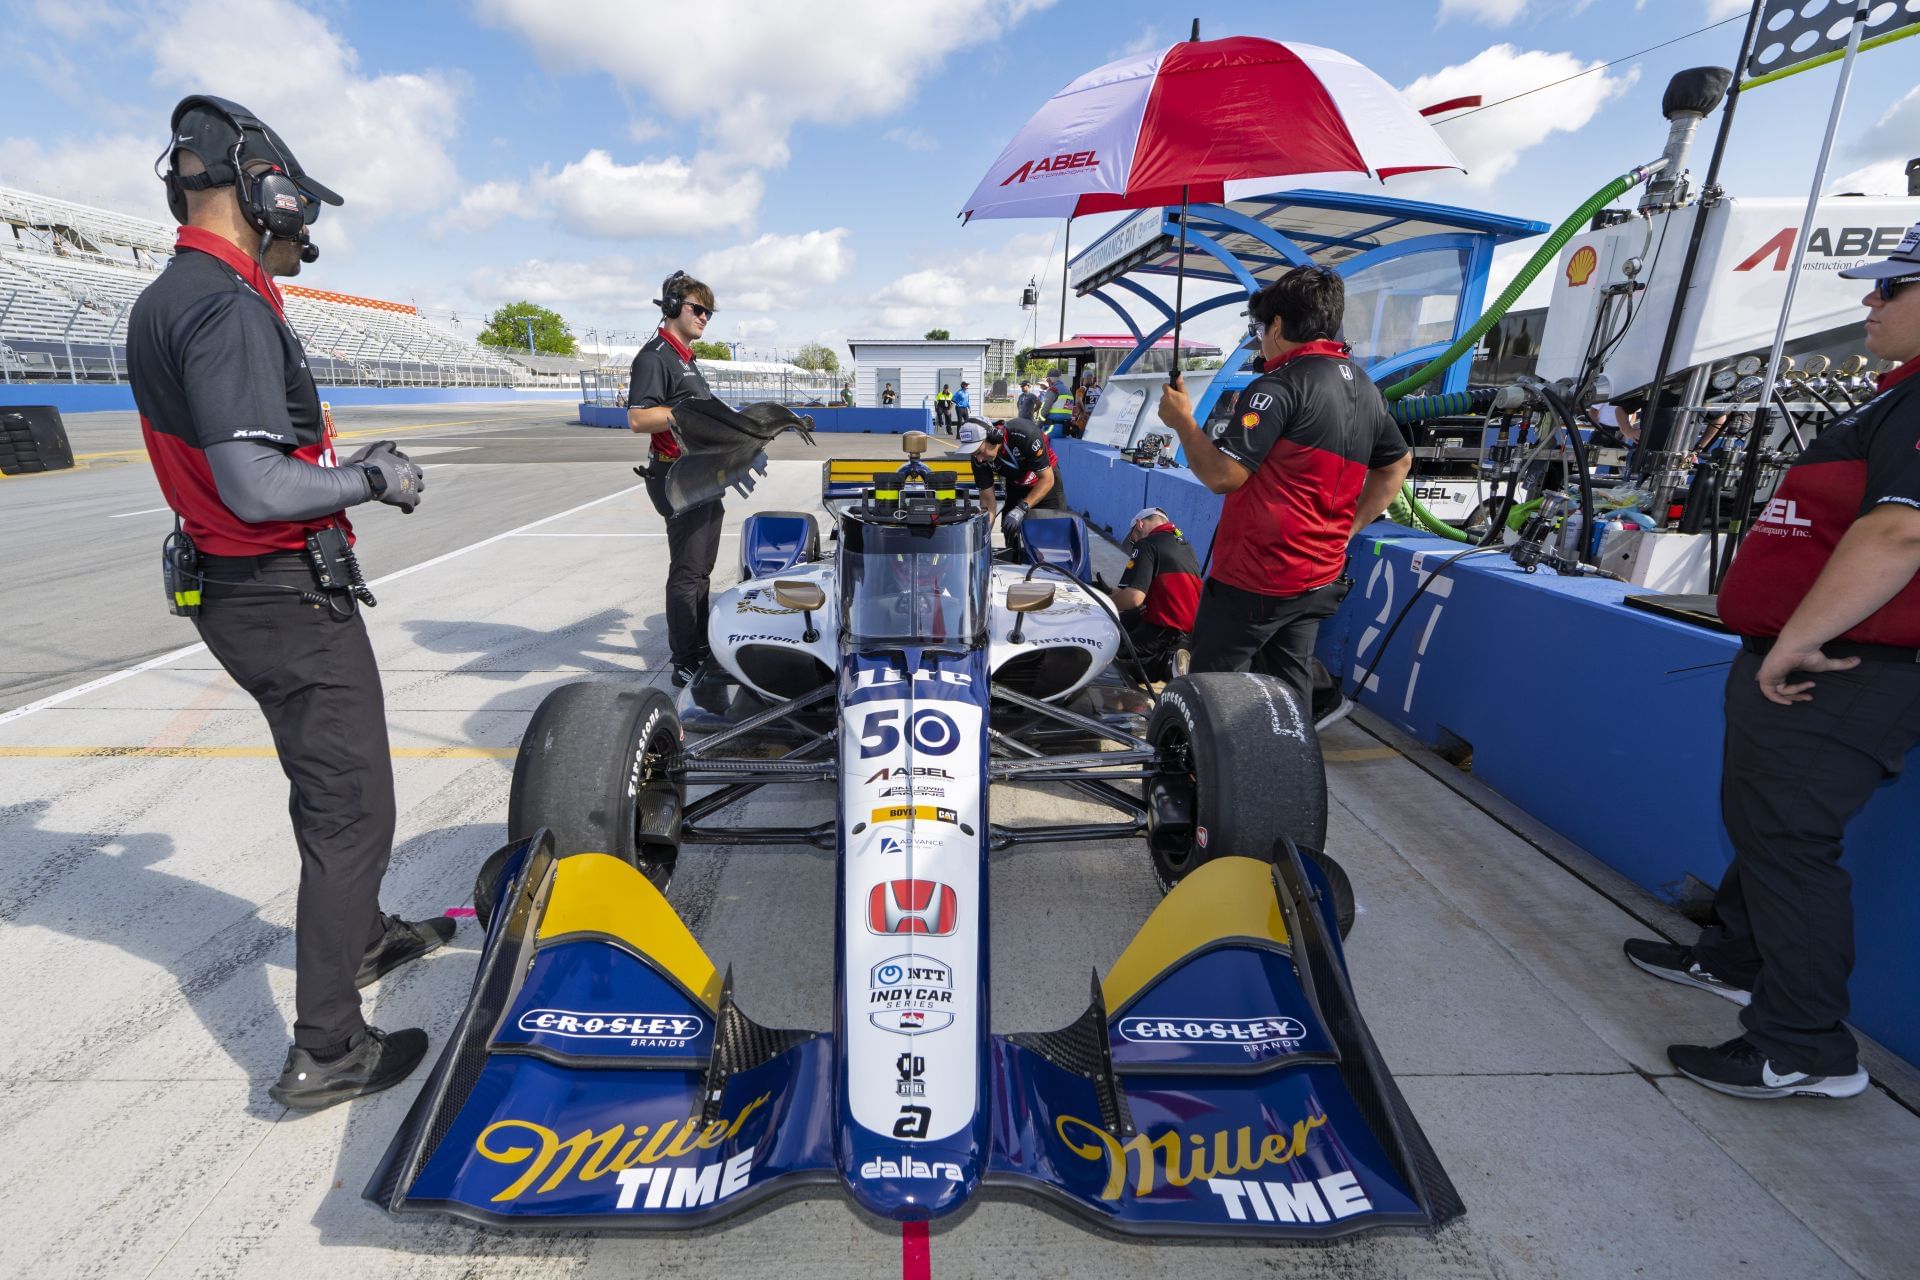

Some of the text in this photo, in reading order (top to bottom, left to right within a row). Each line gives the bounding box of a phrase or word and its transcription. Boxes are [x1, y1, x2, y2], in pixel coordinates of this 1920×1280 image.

[1031, 150, 1101, 174] ABEL
[1083, 231, 1125, 275] PERFORMANCE
[1124, 222, 1138, 253] PIT
[1806, 227, 1910, 257] ABE
[248, 430, 284, 440] IMPACT
[1791, 527, 1812, 538] Inc.
[728, 633, 800, 646] Firestone
[1028, 636, 1104, 650] Firestone
[1160, 690, 1196, 732] Firestone
[860, 708, 961, 760] 50
[628, 707, 660, 799] Firestone
[891, 767, 955, 780] ABEL
[889, 808, 917, 817] BOYD
[938, 810, 956, 821] CAT
[899, 838, 944, 847] ADVANCE
[907, 967, 945, 982] NTT
[870, 988, 953, 1004] INDYCAR
[886, 1000, 934, 1009] SERIES
[536, 1014, 692, 1035] CROSLEY
[1135, 1021, 1290, 1040] CROSLEY
[630, 1038, 686, 1048] BRANDS
[1243, 1039, 1300, 1053] BRANDS
[475, 1091, 772, 1202] Miller
[1055, 1114, 1327, 1200] Miller
[860, 1155, 964, 1182] dallara
[615, 1146, 755, 1209] TIME
[1208, 1170, 1373, 1223] TIME
